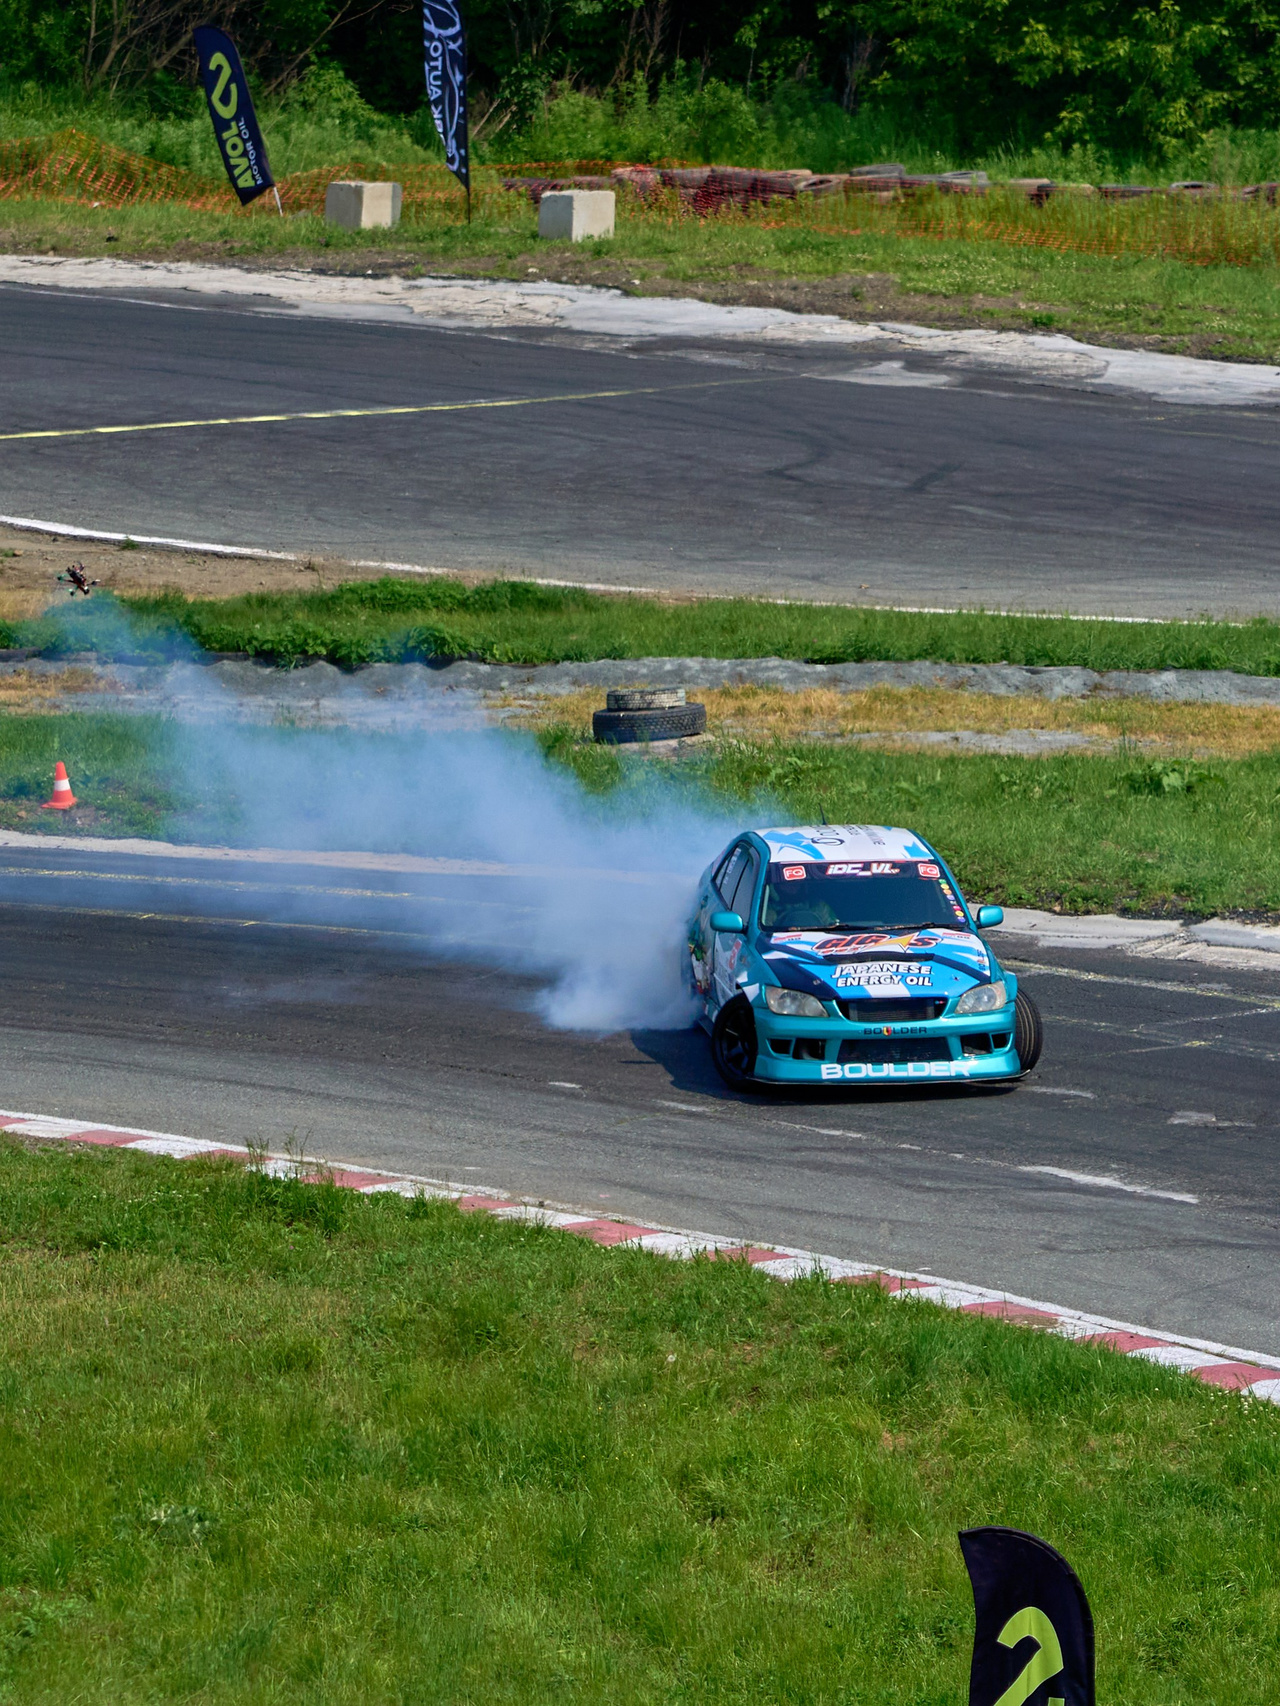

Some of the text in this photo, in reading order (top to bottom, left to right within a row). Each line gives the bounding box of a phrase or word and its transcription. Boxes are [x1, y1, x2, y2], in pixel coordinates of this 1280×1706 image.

[222, 121, 256, 188] AVOL
[238, 116, 263, 185] MOTOR OIL
[786, 870, 803, 878] FQ
[920, 866, 938, 875] FQ
[832, 963, 933, 978] JAPANESE
[836, 974, 933, 987] ENERGY OIL
[820, 1061, 970, 1079] BOULDER
